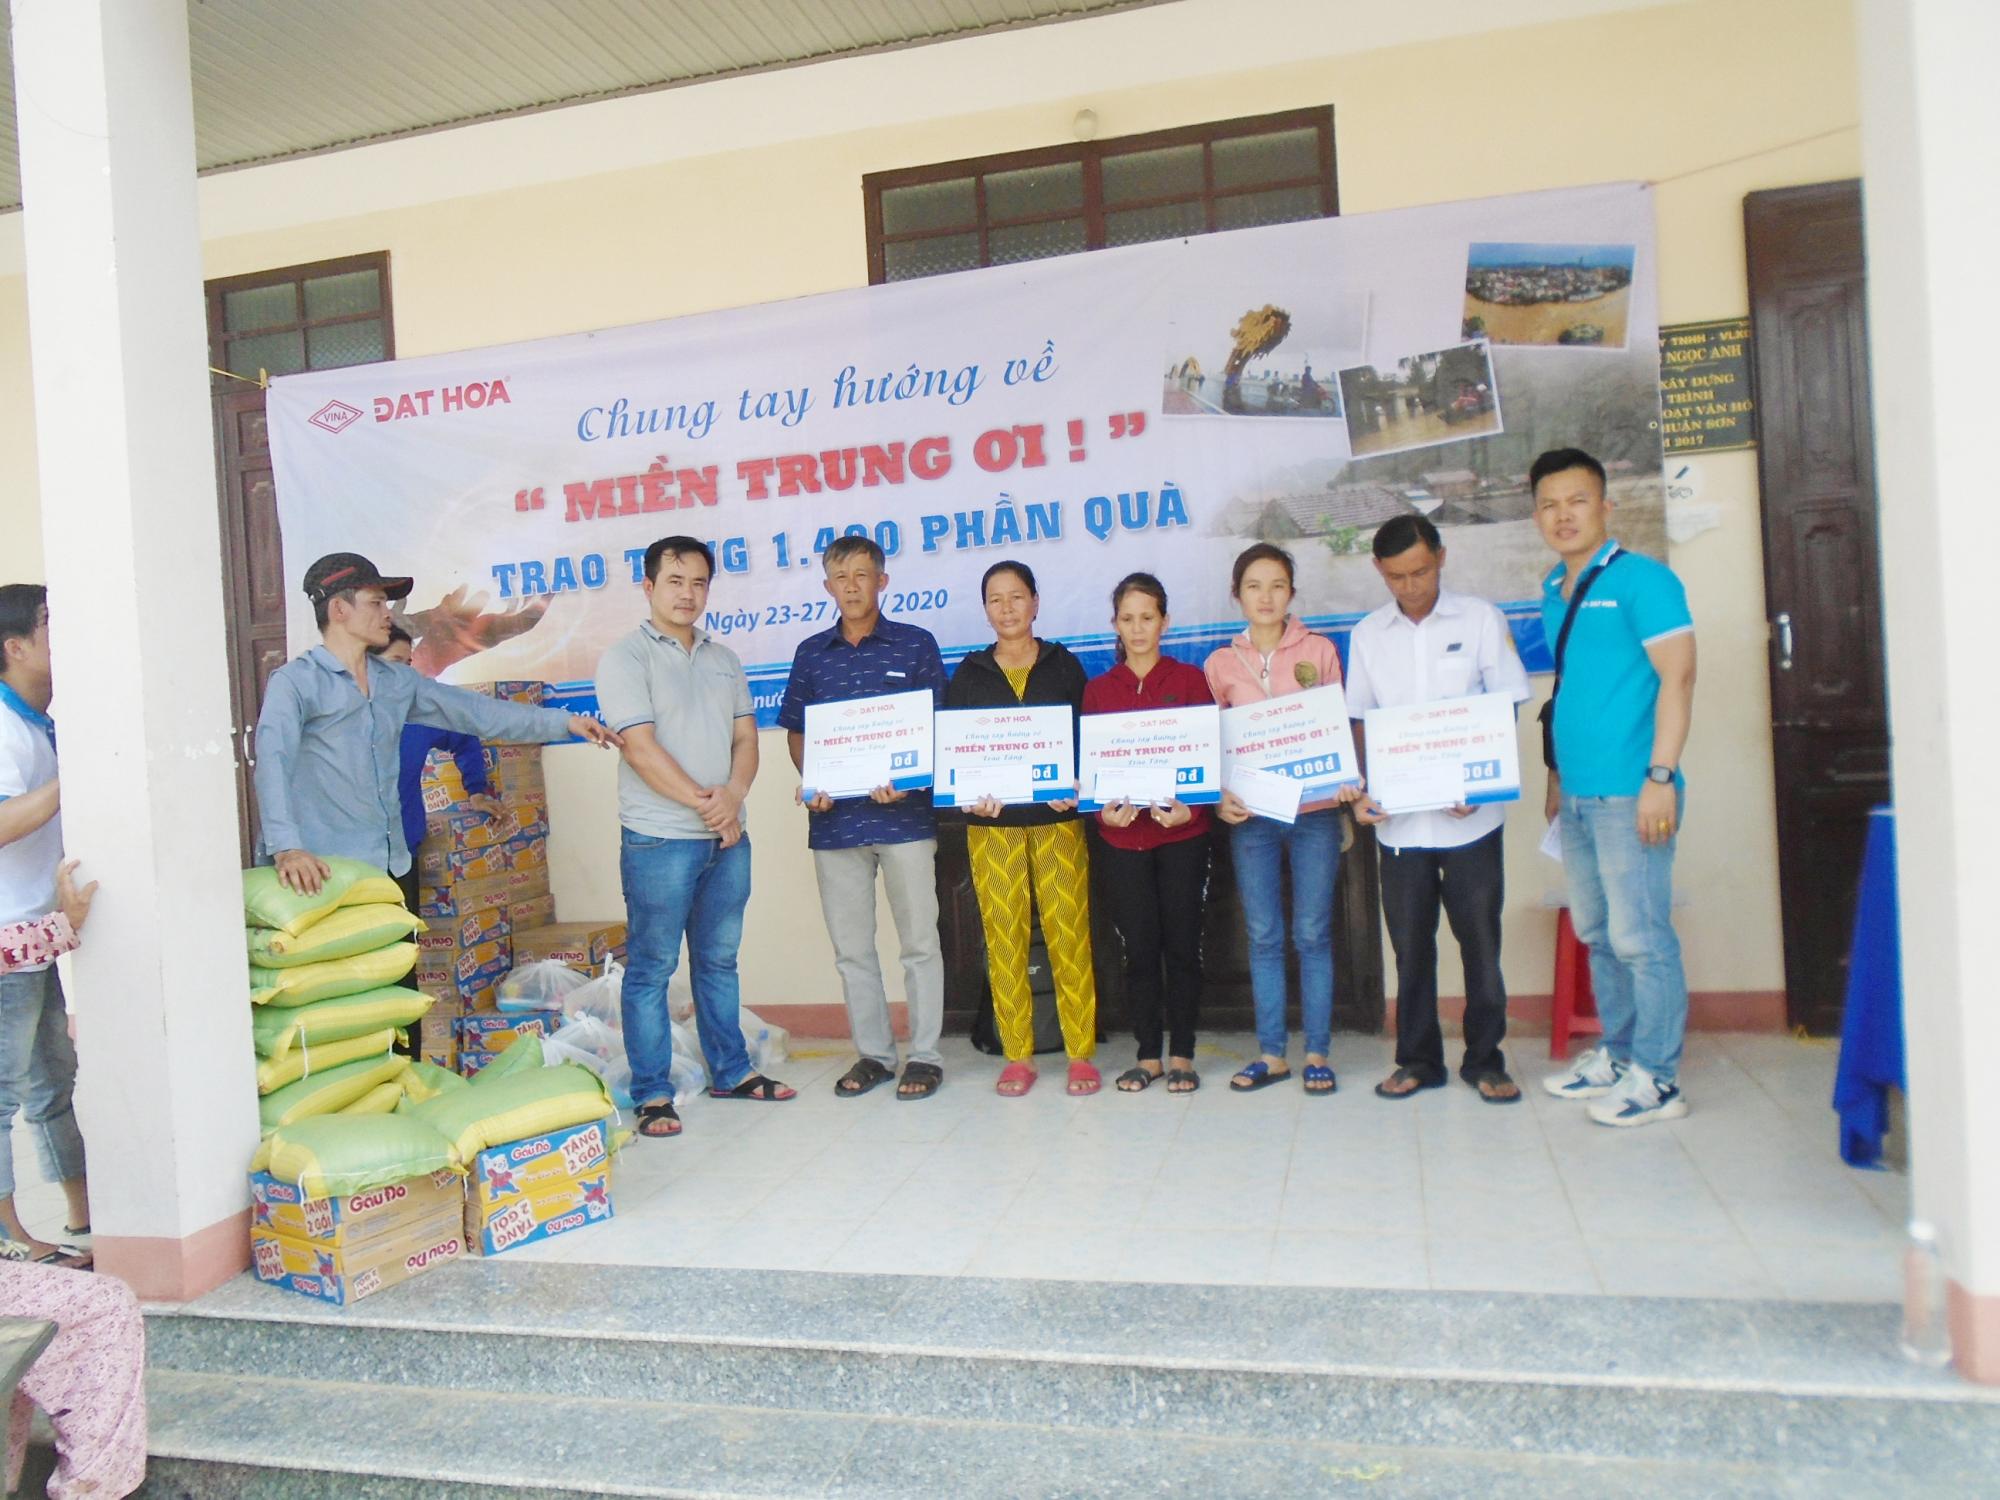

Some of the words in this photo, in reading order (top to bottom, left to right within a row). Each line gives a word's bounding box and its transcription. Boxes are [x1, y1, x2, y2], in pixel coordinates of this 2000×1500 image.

[323, 411, 348, 422] VINA
[577, 397, 722, 442] Chung
[738, 384, 818, 428] tay
[832, 363, 987, 409] hướng
[1003, 339, 1060, 386] về
[563, 455, 719, 523] MIỀN
[736, 435, 952, 502] TRUNG
[973, 422, 1046, 475] ƠI
[491, 553, 607, 599] TRAO
[623, 536, 749, 585] TG
[920, 491, 1063, 553] PHẦN
[1083, 480, 1189, 542] QUÀ
[704, 608, 760, 636] Ngày
[765, 601, 828, 626] 23-27
[891, 588, 949, 614] 2020
[753, 688, 786, 708] nướ
